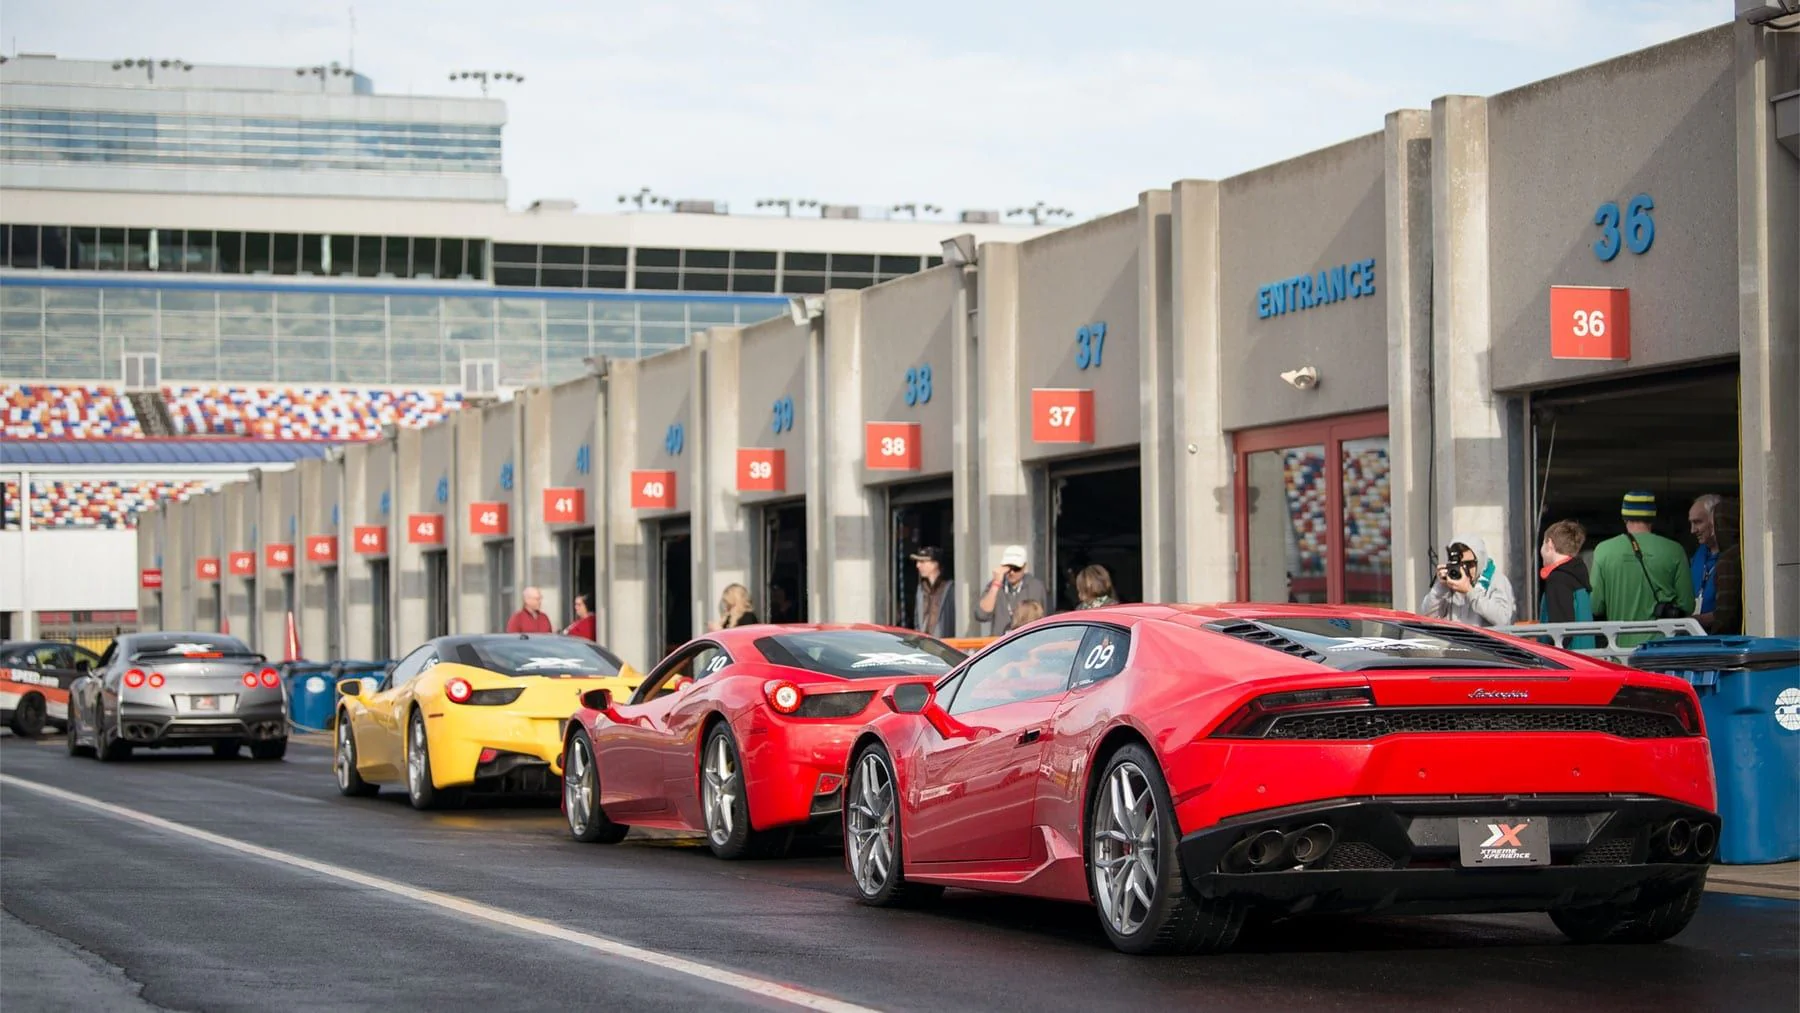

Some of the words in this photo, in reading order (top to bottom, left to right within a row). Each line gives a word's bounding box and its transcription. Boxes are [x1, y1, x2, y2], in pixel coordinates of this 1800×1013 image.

[1593, 193, 1655, 262] 36
[1258, 258, 1376, 319] ENTRANCE
[1572, 310, 1605, 337] 36
[1075, 321, 1107, 370] 37
[904, 363, 932, 407] 38
[772, 395, 794, 433] 39
[1049, 406, 1076, 427] 37
[665, 422, 684, 456] 40
[881, 437, 906, 456] 38
[749, 461, 771, 479] 39
[642, 482, 664, 498] 40
[555, 498, 573, 513] 41
[417, 521, 435, 536] 43
[480, 512, 498, 526] 42
[706, 655, 727, 672] 10
[1084, 644, 1115, 669] 09
